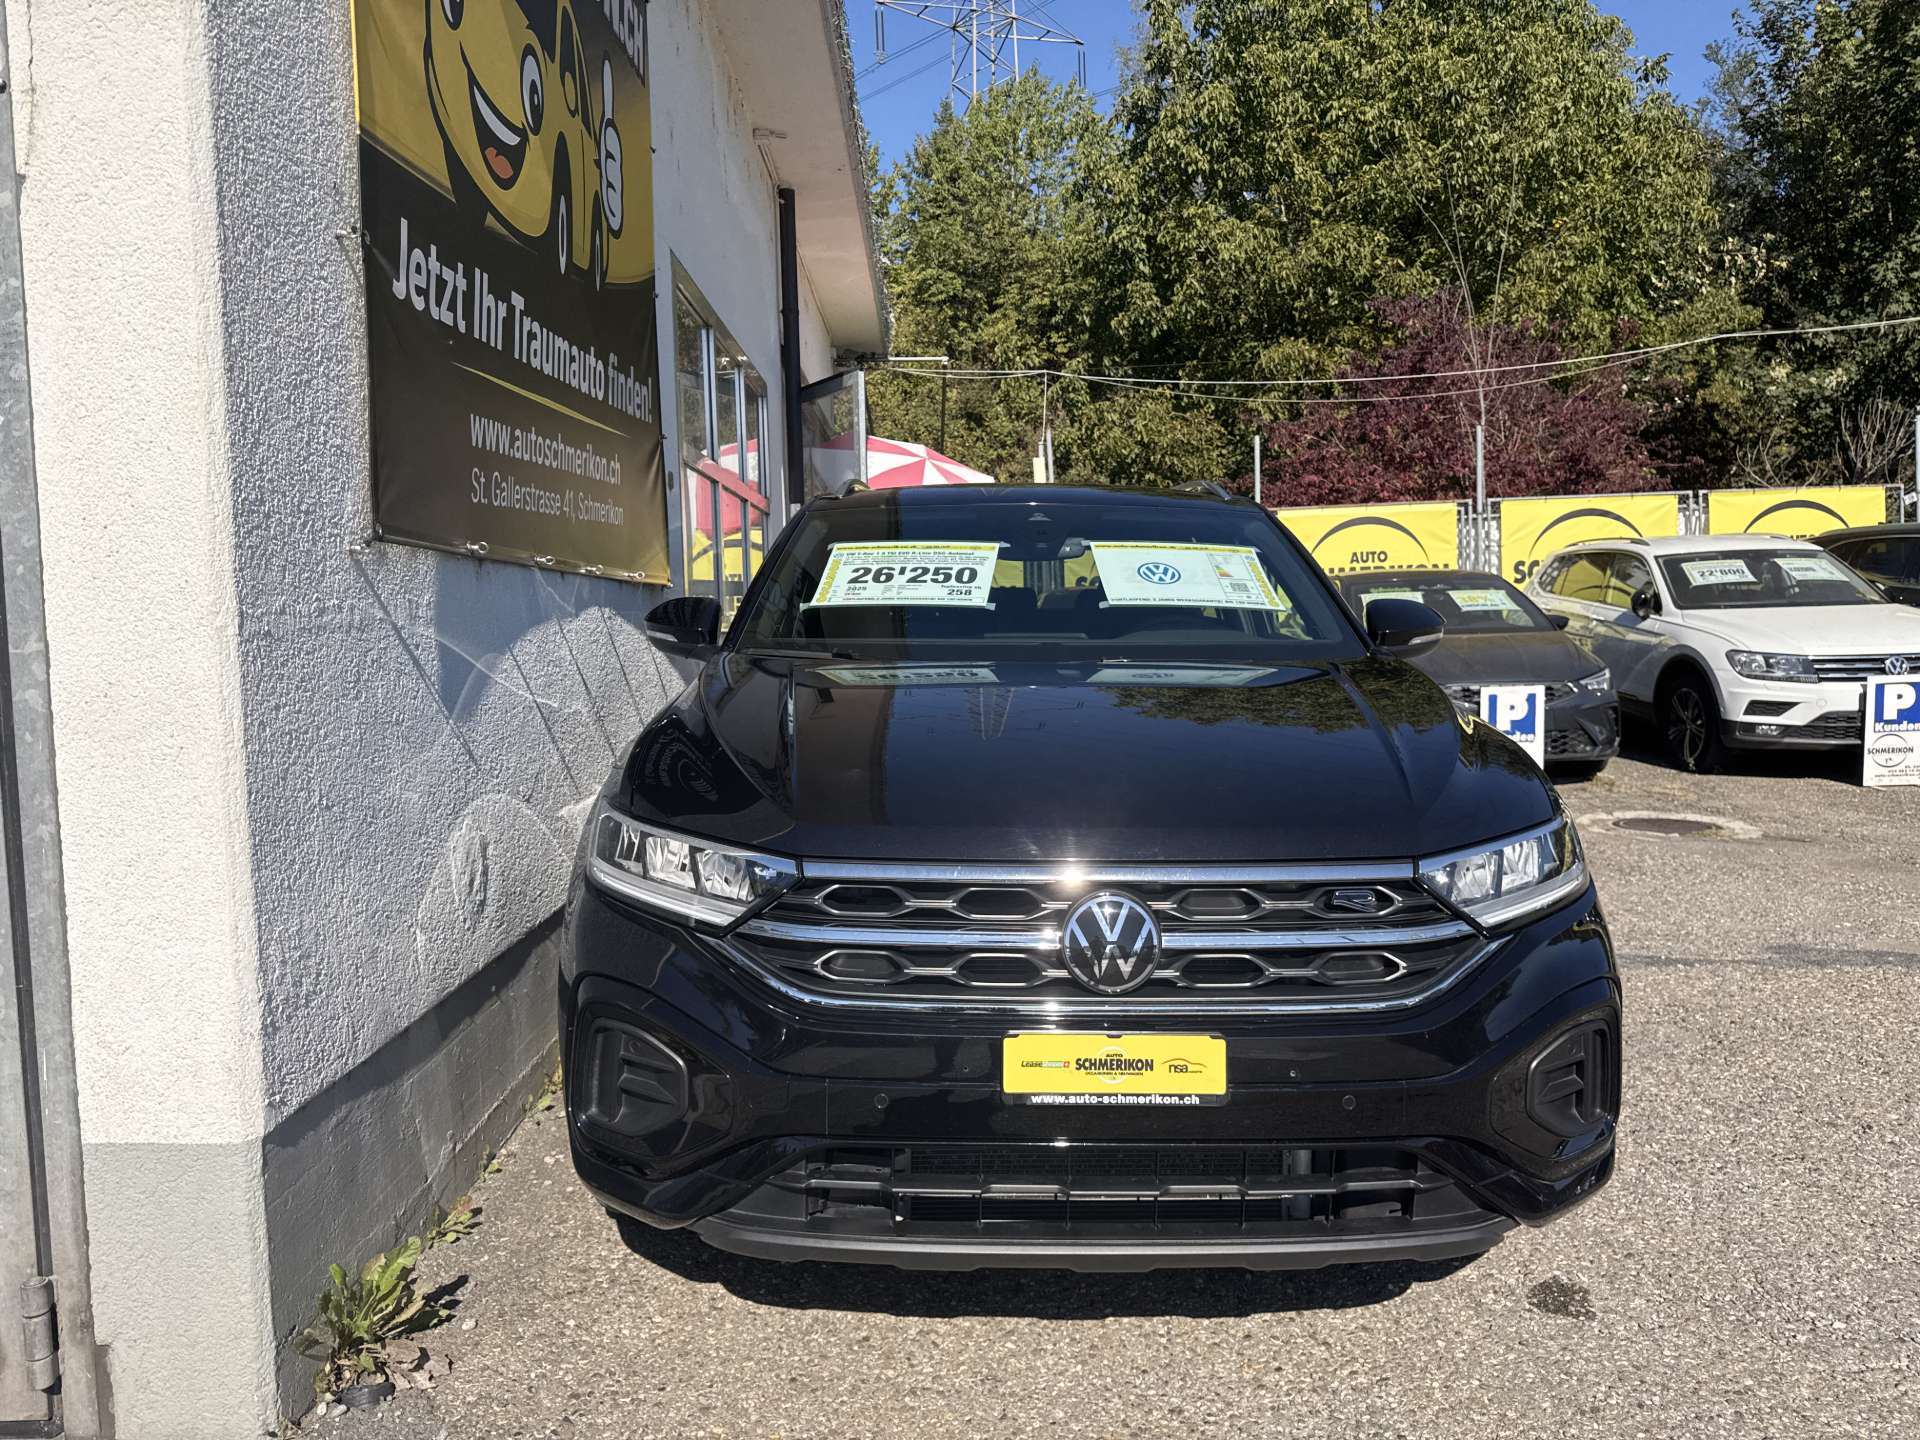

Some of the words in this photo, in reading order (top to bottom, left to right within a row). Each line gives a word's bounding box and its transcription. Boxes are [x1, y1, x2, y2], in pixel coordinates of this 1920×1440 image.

[392, 217, 467, 334] Jetzt
[473, 267, 507, 351] Ihr
[511, 290, 605, 401] Traumauto
[608, 352, 653, 424] finden!
[470, 413, 621, 486] www.autoschmerikon.ch
[471, 467, 489, 505] St.
[491, 471, 561, 516] Gallerstrasse
[563, 489, 576, 523] 41,
[578, 492, 624, 526] Schmerikon
[1350, 551, 1388, 564] AUTO
[846, 566, 979, 584] 26'250
[1867, 747, 1914, 755] SCHMERIKON
[1075, 1058, 1154, 1071] SCHMERIKON
[1031, 1093, 1200, 1105] www.auto-schmerikon.ch
